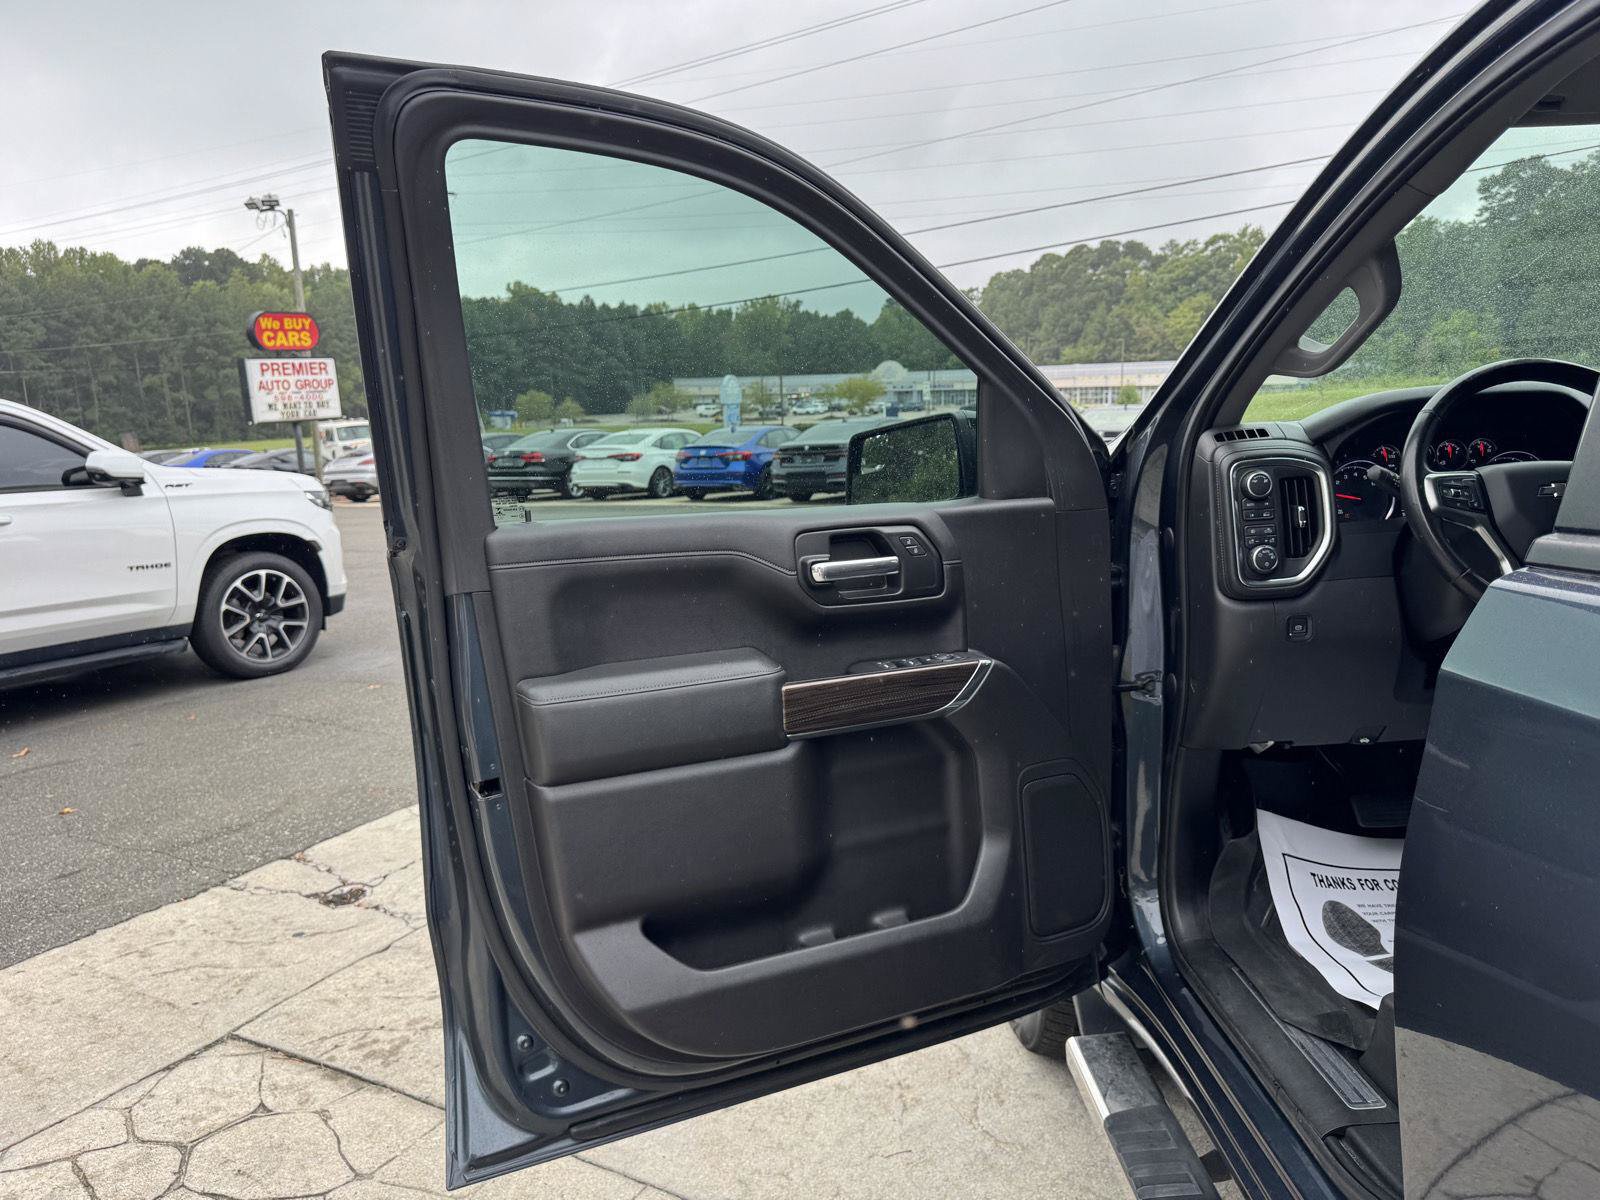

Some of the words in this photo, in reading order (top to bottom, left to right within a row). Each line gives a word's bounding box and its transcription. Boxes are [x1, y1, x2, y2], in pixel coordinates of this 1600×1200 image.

[260, 317, 280, 329] We
[283, 317, 312, 329] BUY
[262, 331, 312, 347] CARS
[260, 362, 329, 376] PREMIER
[258, 379, 291, 392] AUTO
[295, 379, 334, 390] GROUP
[127, 562, 172, 572] TAHOE
[1310, 872, 1357, 890] THANKS
[1357, 879, 1384, 891] FOR
